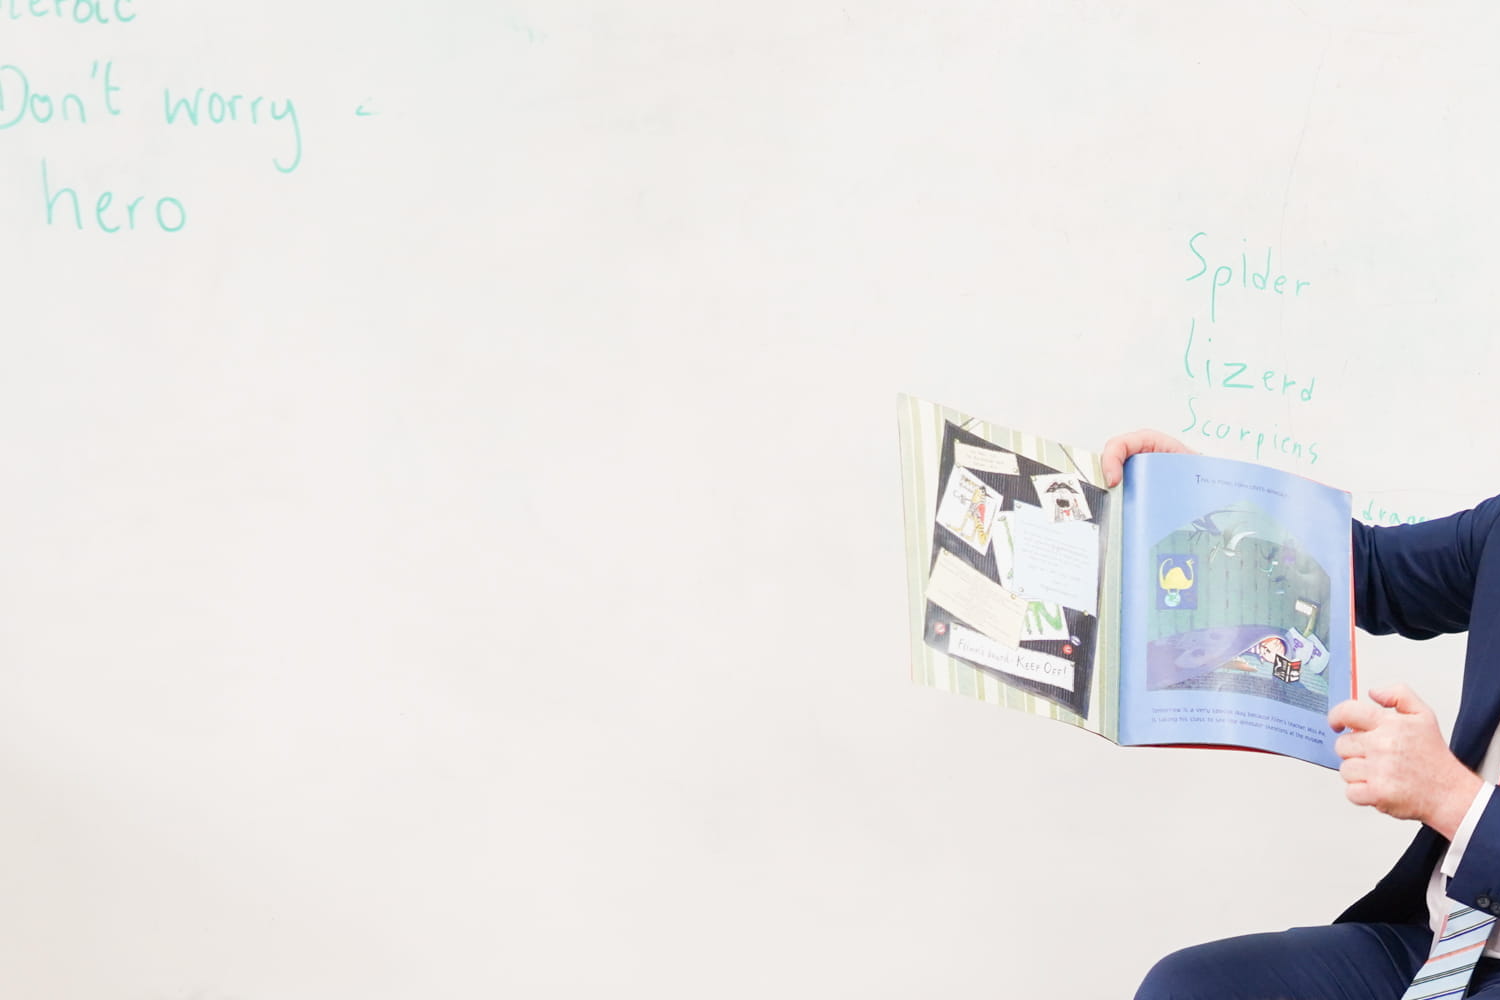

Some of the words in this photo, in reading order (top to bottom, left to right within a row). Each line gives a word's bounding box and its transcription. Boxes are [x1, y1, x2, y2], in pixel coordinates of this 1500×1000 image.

[0, 60, 120, 129] Don't
[164, 87, 301, 173] worry
[41, 156, 186, 233] hero
[1185, 231, 1312, 323] Spider
